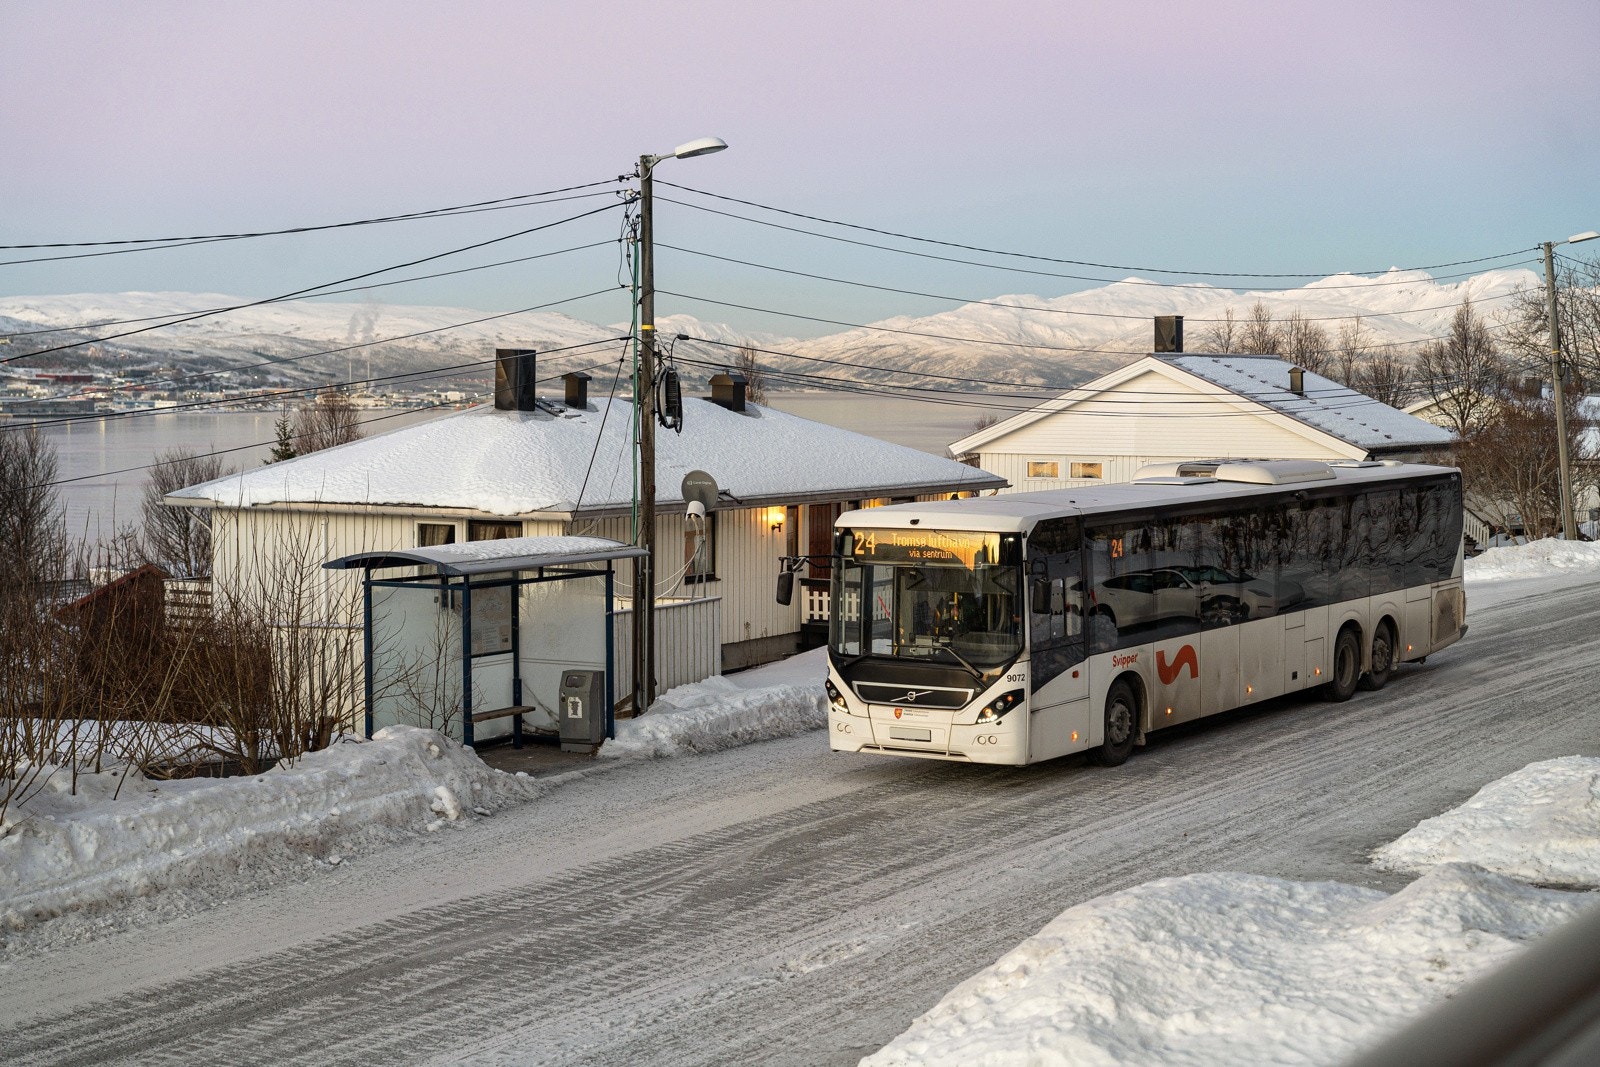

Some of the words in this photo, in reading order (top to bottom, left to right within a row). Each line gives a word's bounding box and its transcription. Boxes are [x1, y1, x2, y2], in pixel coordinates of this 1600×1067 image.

[854, 532, 875, 555] 24
[891, 533, 926, 548] Tromsø
[928, 534, 970, 549] lufthavn
[1111, 539, 1123, 558] 24
[909, 549, 921, 558] via
[922, 550, 953, 559] sentrum
[1112, 653, 1138, 668] Svipper
[1006, 673, 1026, 683] 9072
